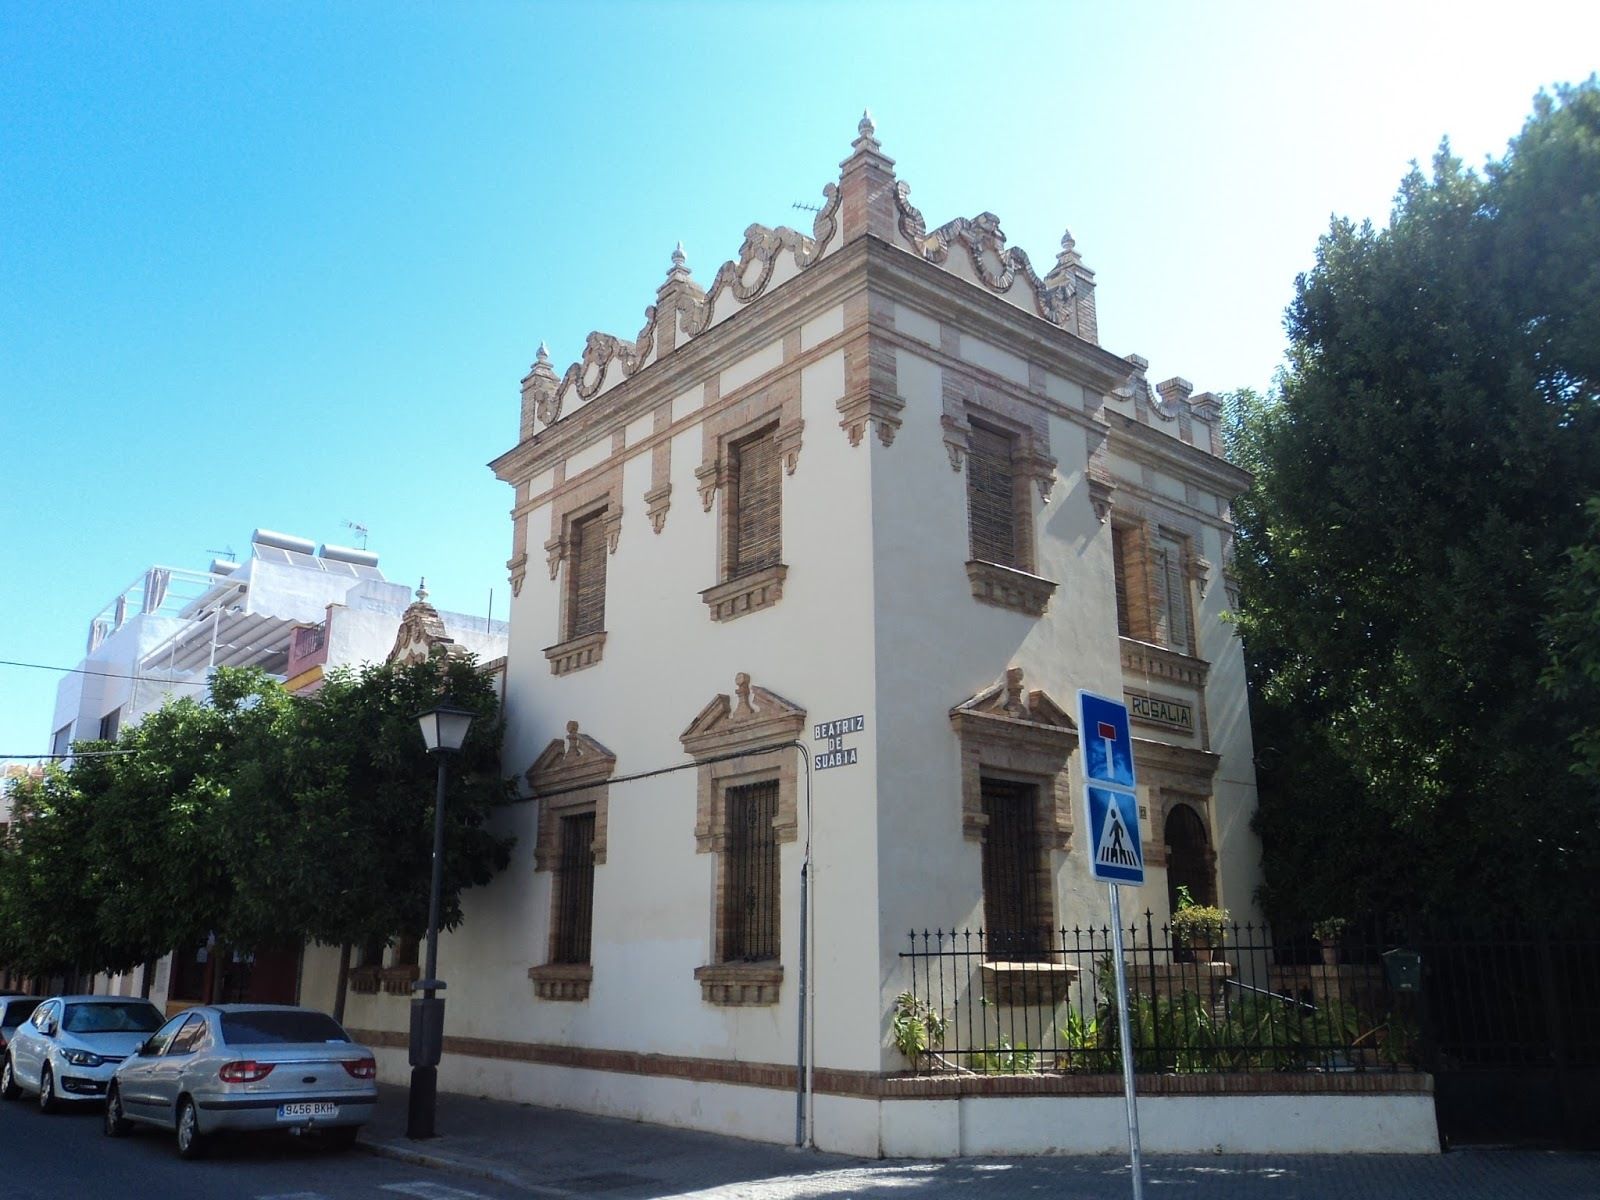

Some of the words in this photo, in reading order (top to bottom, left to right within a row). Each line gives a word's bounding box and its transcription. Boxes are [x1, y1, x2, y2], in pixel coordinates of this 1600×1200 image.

[1132, 697, 1189, 725] ROSALIA
[815, 717, 863, 739] BEATRIZ
[829, 737, 842, 751] DE
[815, 750, 857, 769] SUABIA
[286, 1104, 311, 1115] 9456
[314, 1103, 333, 1114] BKH
